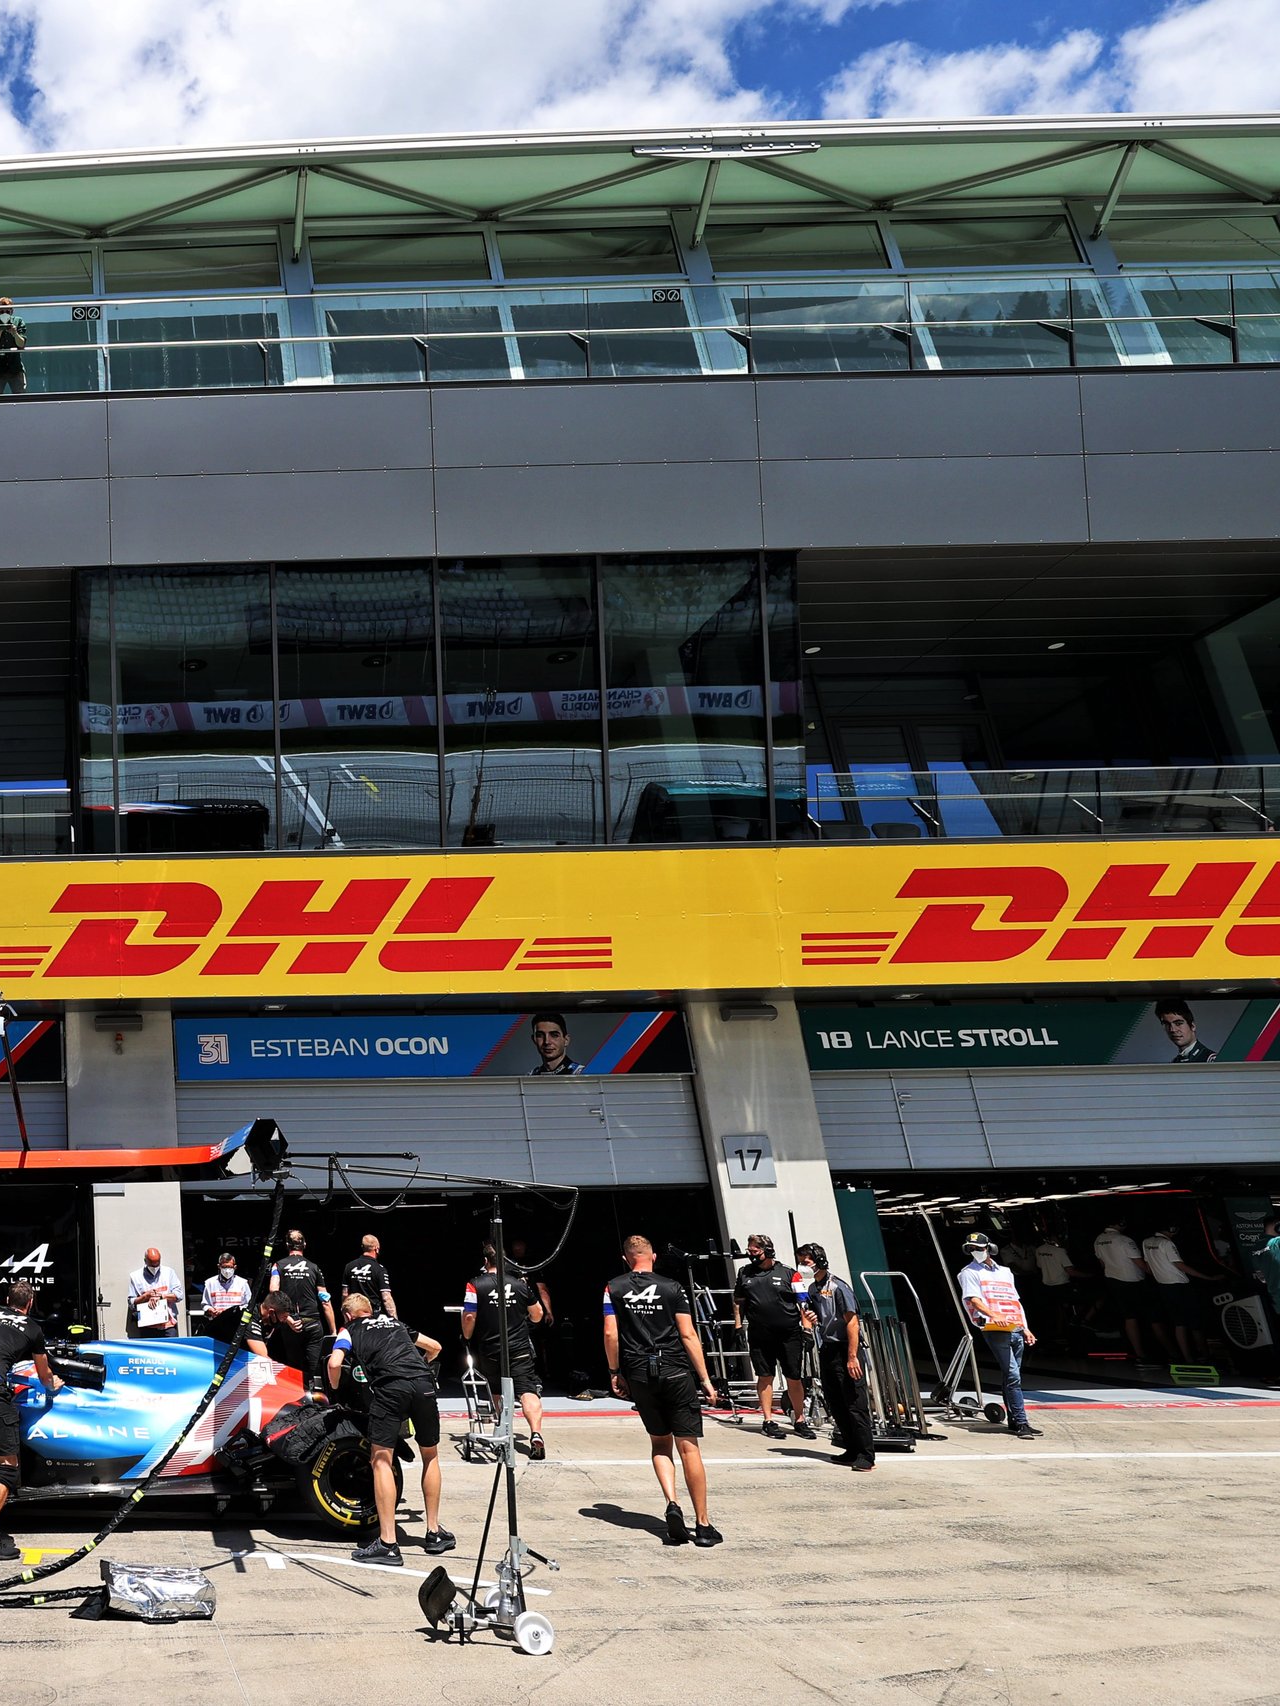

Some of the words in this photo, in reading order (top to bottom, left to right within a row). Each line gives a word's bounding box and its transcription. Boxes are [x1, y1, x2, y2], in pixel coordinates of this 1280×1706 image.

[44, 877, 524, 977] DHL
[197, 1034, 230, 1065] 31
[251, 1038, 369, 1057] ESTEBAN
[375, 1036, 449, 1056] OCON
[816, 1031, 853, 1049] 18
[866, 1029, 955, 1049] LANCE
[958, 1028, 1059, 1047] STROLL
[734, 1149, 762, 1171] 17
[118, 1366, 177, 1376] E-TECH
[27, 1426, 151, 1441] ALPINE
[312, 1442, 337, 1478] PIRELLI
